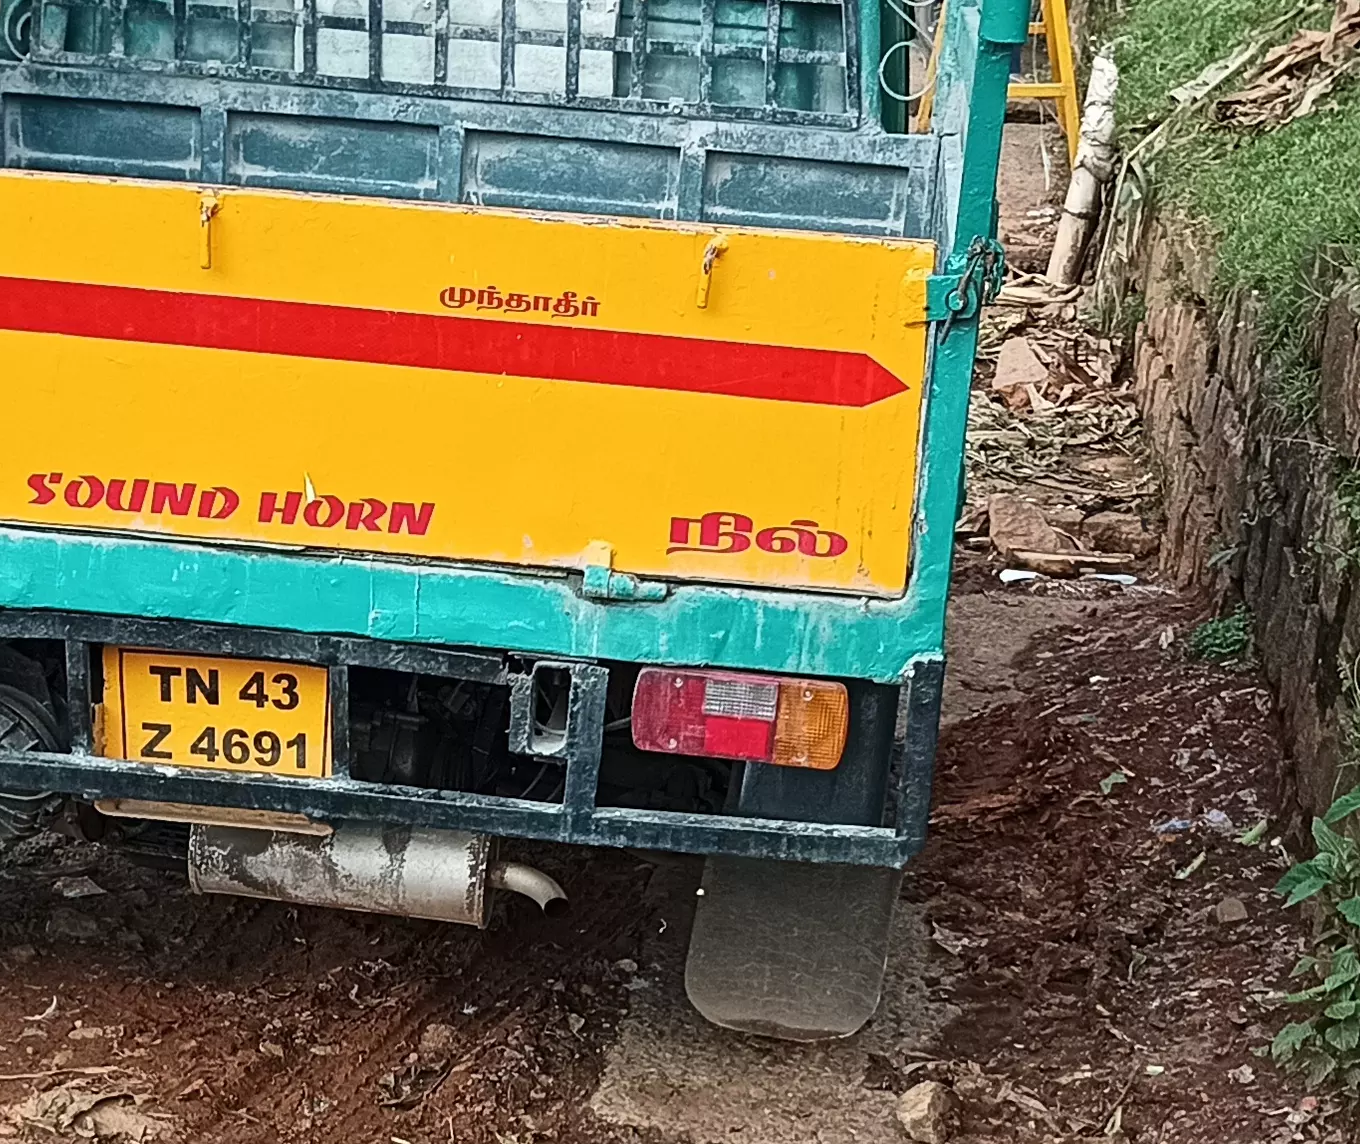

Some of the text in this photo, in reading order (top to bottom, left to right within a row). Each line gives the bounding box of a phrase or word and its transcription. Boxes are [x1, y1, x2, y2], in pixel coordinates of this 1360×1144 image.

[440, 285, 601, 319] முந்தாதீர்
[27, 472, 436, 536] SOUND HORN
[665, 511, 848, 558] நில்
[148, 665, 300, 710] TN 43
[140, 722, 308, 769] Z 4691
